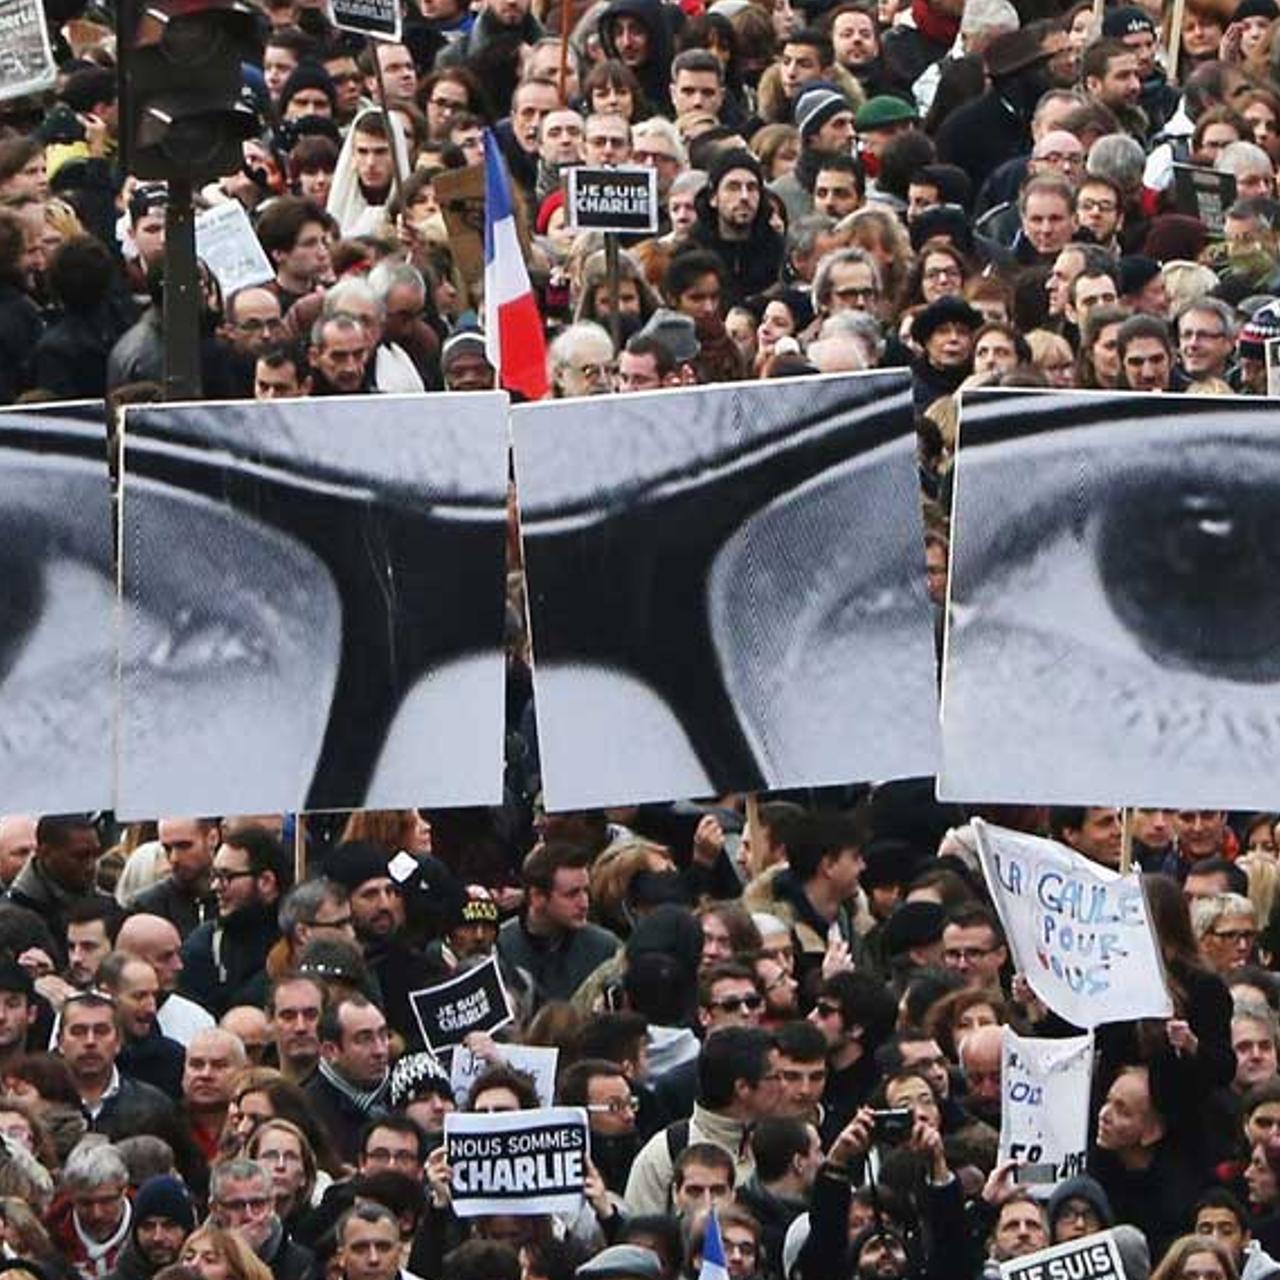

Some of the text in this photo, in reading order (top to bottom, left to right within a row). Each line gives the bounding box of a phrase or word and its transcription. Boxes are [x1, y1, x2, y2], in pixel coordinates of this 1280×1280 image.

[577, 183, 648, 199] JE SUIS
[577, 197, 649, 215] CHARLIE
[993, 854, 1022, 895] LA
[1043, 915, 1129, 961] POUR
[450, 1128, 584, 1158] NOUS SOMMES
[450, 1151, 584, 1193] CHARLIE
